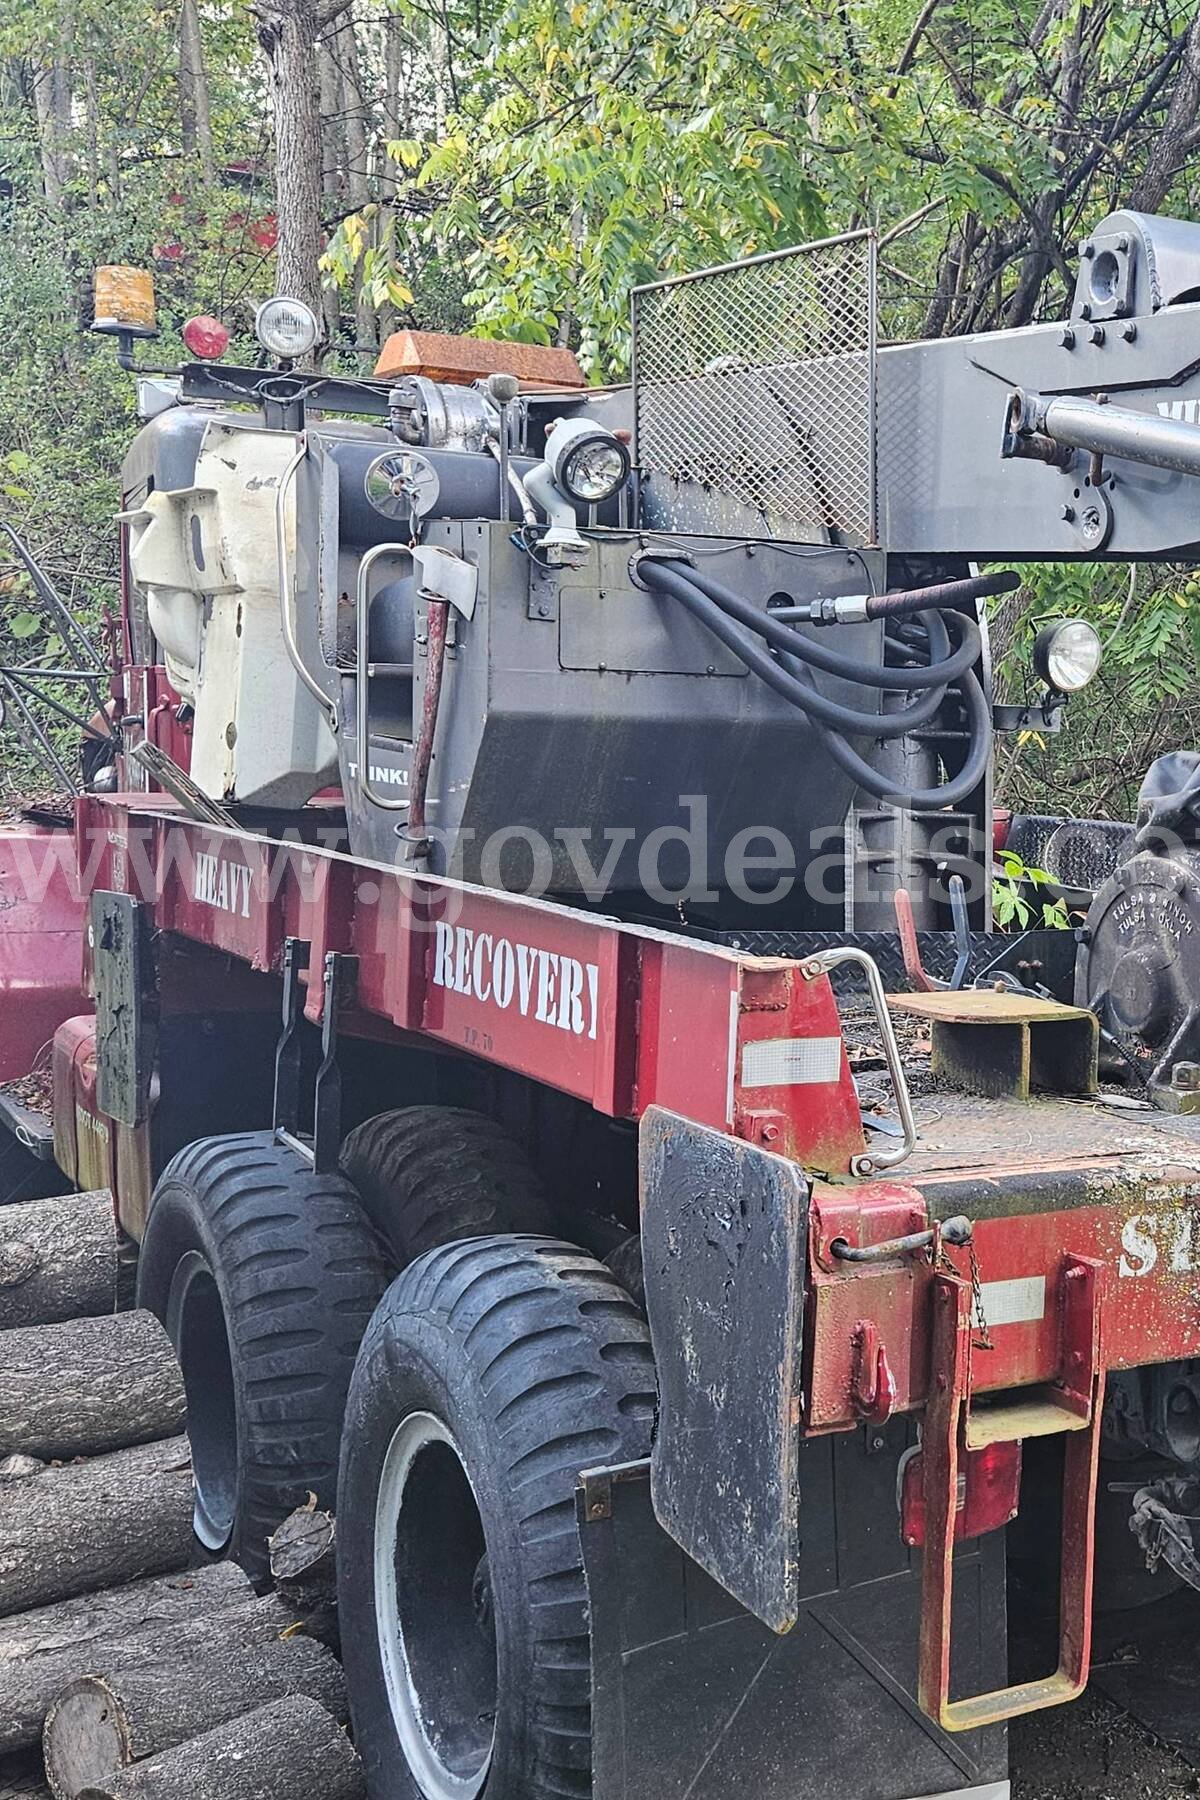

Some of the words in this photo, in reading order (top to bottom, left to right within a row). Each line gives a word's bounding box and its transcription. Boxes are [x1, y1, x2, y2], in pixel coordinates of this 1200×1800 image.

[348, 762, 409, 786] TINK!
[194, 851, 254, 918] HEAVY
[1112, 892, 1143, 920] TULSA
[1118, 907, 1146, 934] TULSA
